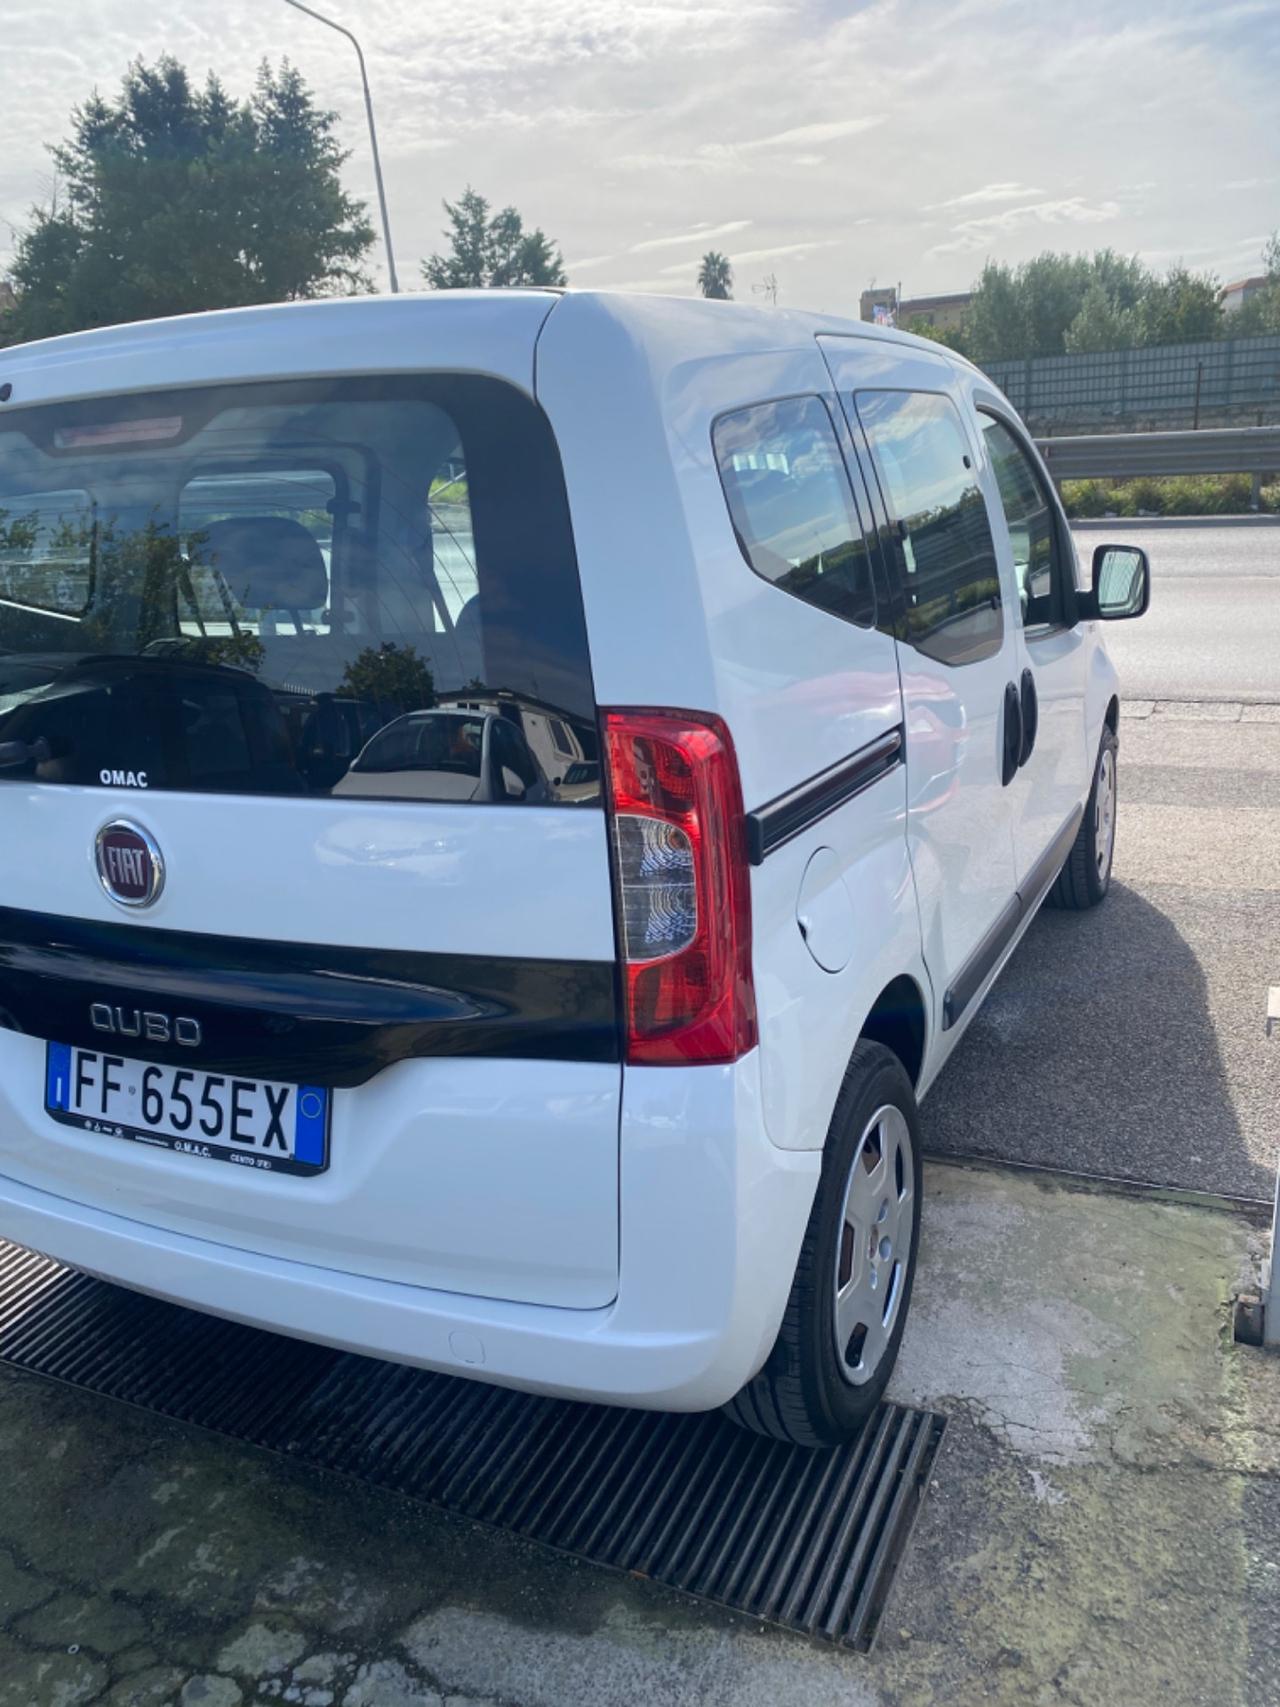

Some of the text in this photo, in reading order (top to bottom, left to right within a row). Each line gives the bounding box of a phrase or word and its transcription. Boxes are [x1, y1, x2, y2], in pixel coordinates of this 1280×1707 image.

[100, 769, 148, 788] OMAC
[107, 847, 145, 887] FIAT
[90, 1003, 201, 1047] QUBO
[75, 1050, 290, 1151] FF 655EX
